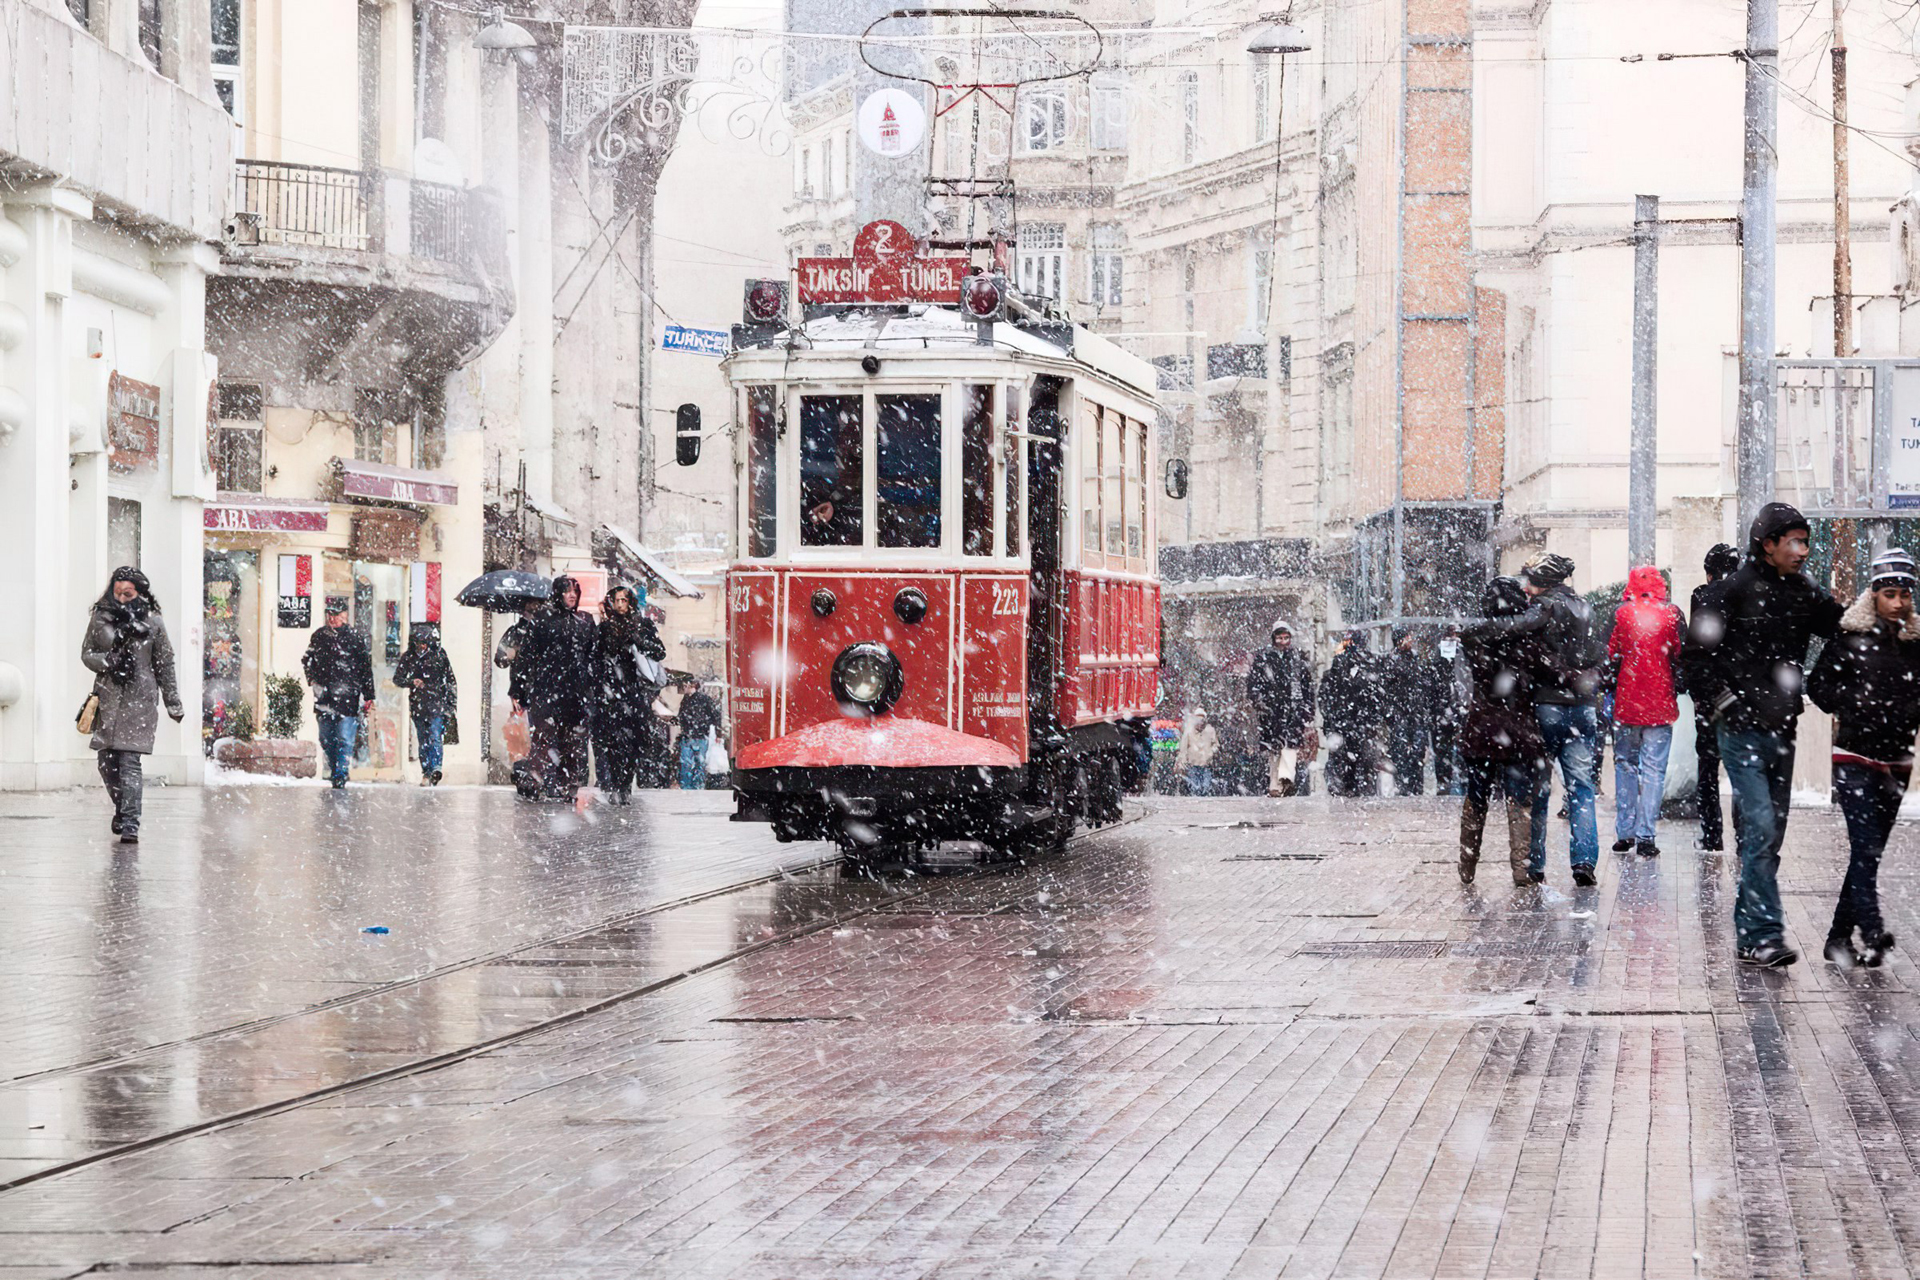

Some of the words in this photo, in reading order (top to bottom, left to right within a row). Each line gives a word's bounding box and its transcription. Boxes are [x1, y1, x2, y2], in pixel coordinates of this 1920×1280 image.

[876, 225, 895, 253] 2
[218, 509, 251, 530] ABA
[992, 587, 1019, 615] 223
